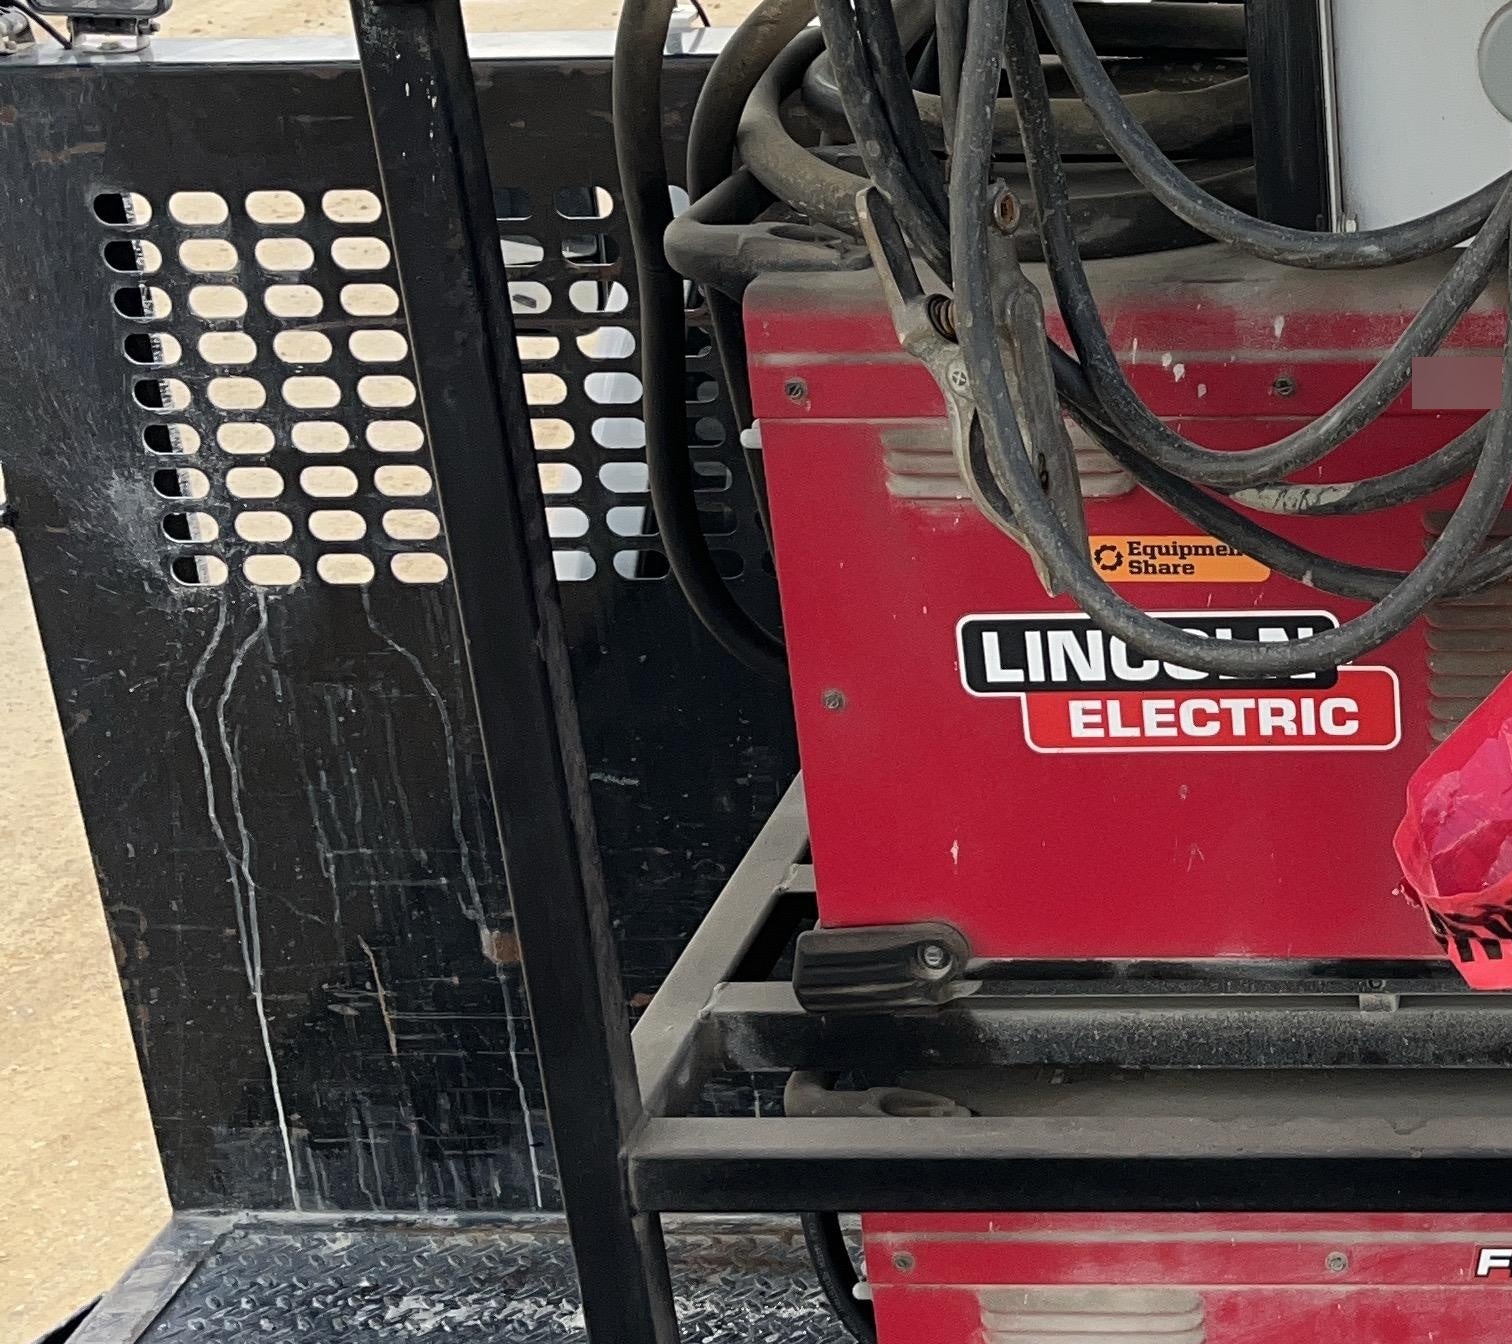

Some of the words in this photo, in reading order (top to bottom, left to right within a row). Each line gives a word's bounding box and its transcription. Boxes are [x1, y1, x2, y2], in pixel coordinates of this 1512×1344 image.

[1127, 540, 1244, 560] Equipmen
[1128, 559, 1195, 575] Share
[1067, 697, 1360, 738] ELECTRIC
